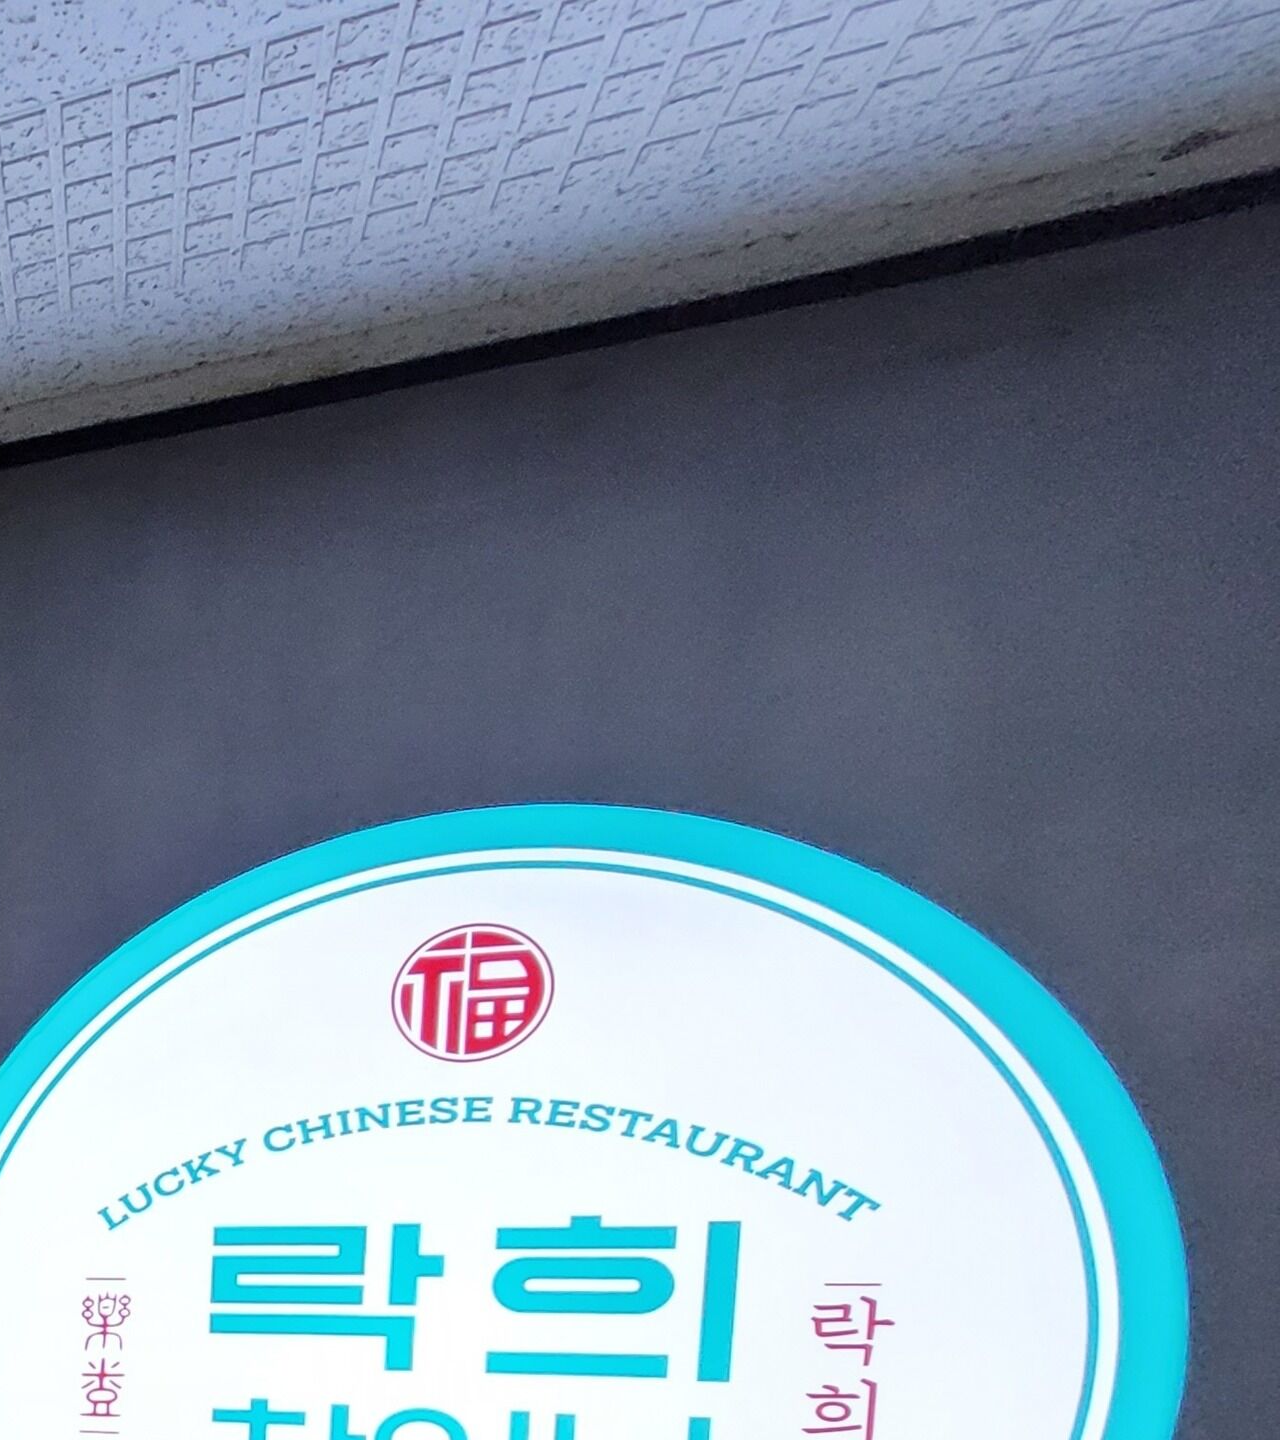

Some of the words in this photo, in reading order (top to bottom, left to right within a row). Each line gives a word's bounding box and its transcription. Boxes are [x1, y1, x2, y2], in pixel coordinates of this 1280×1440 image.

[395, 926, 550, 1060] 福
[96, 1137, 248, 1233] LUCKY
[262, 1096, 494, 1154] CHINESE
[507, 1096, 883, 1223] RESTAURANT
[208, 1215, 743, 1384] 락희
